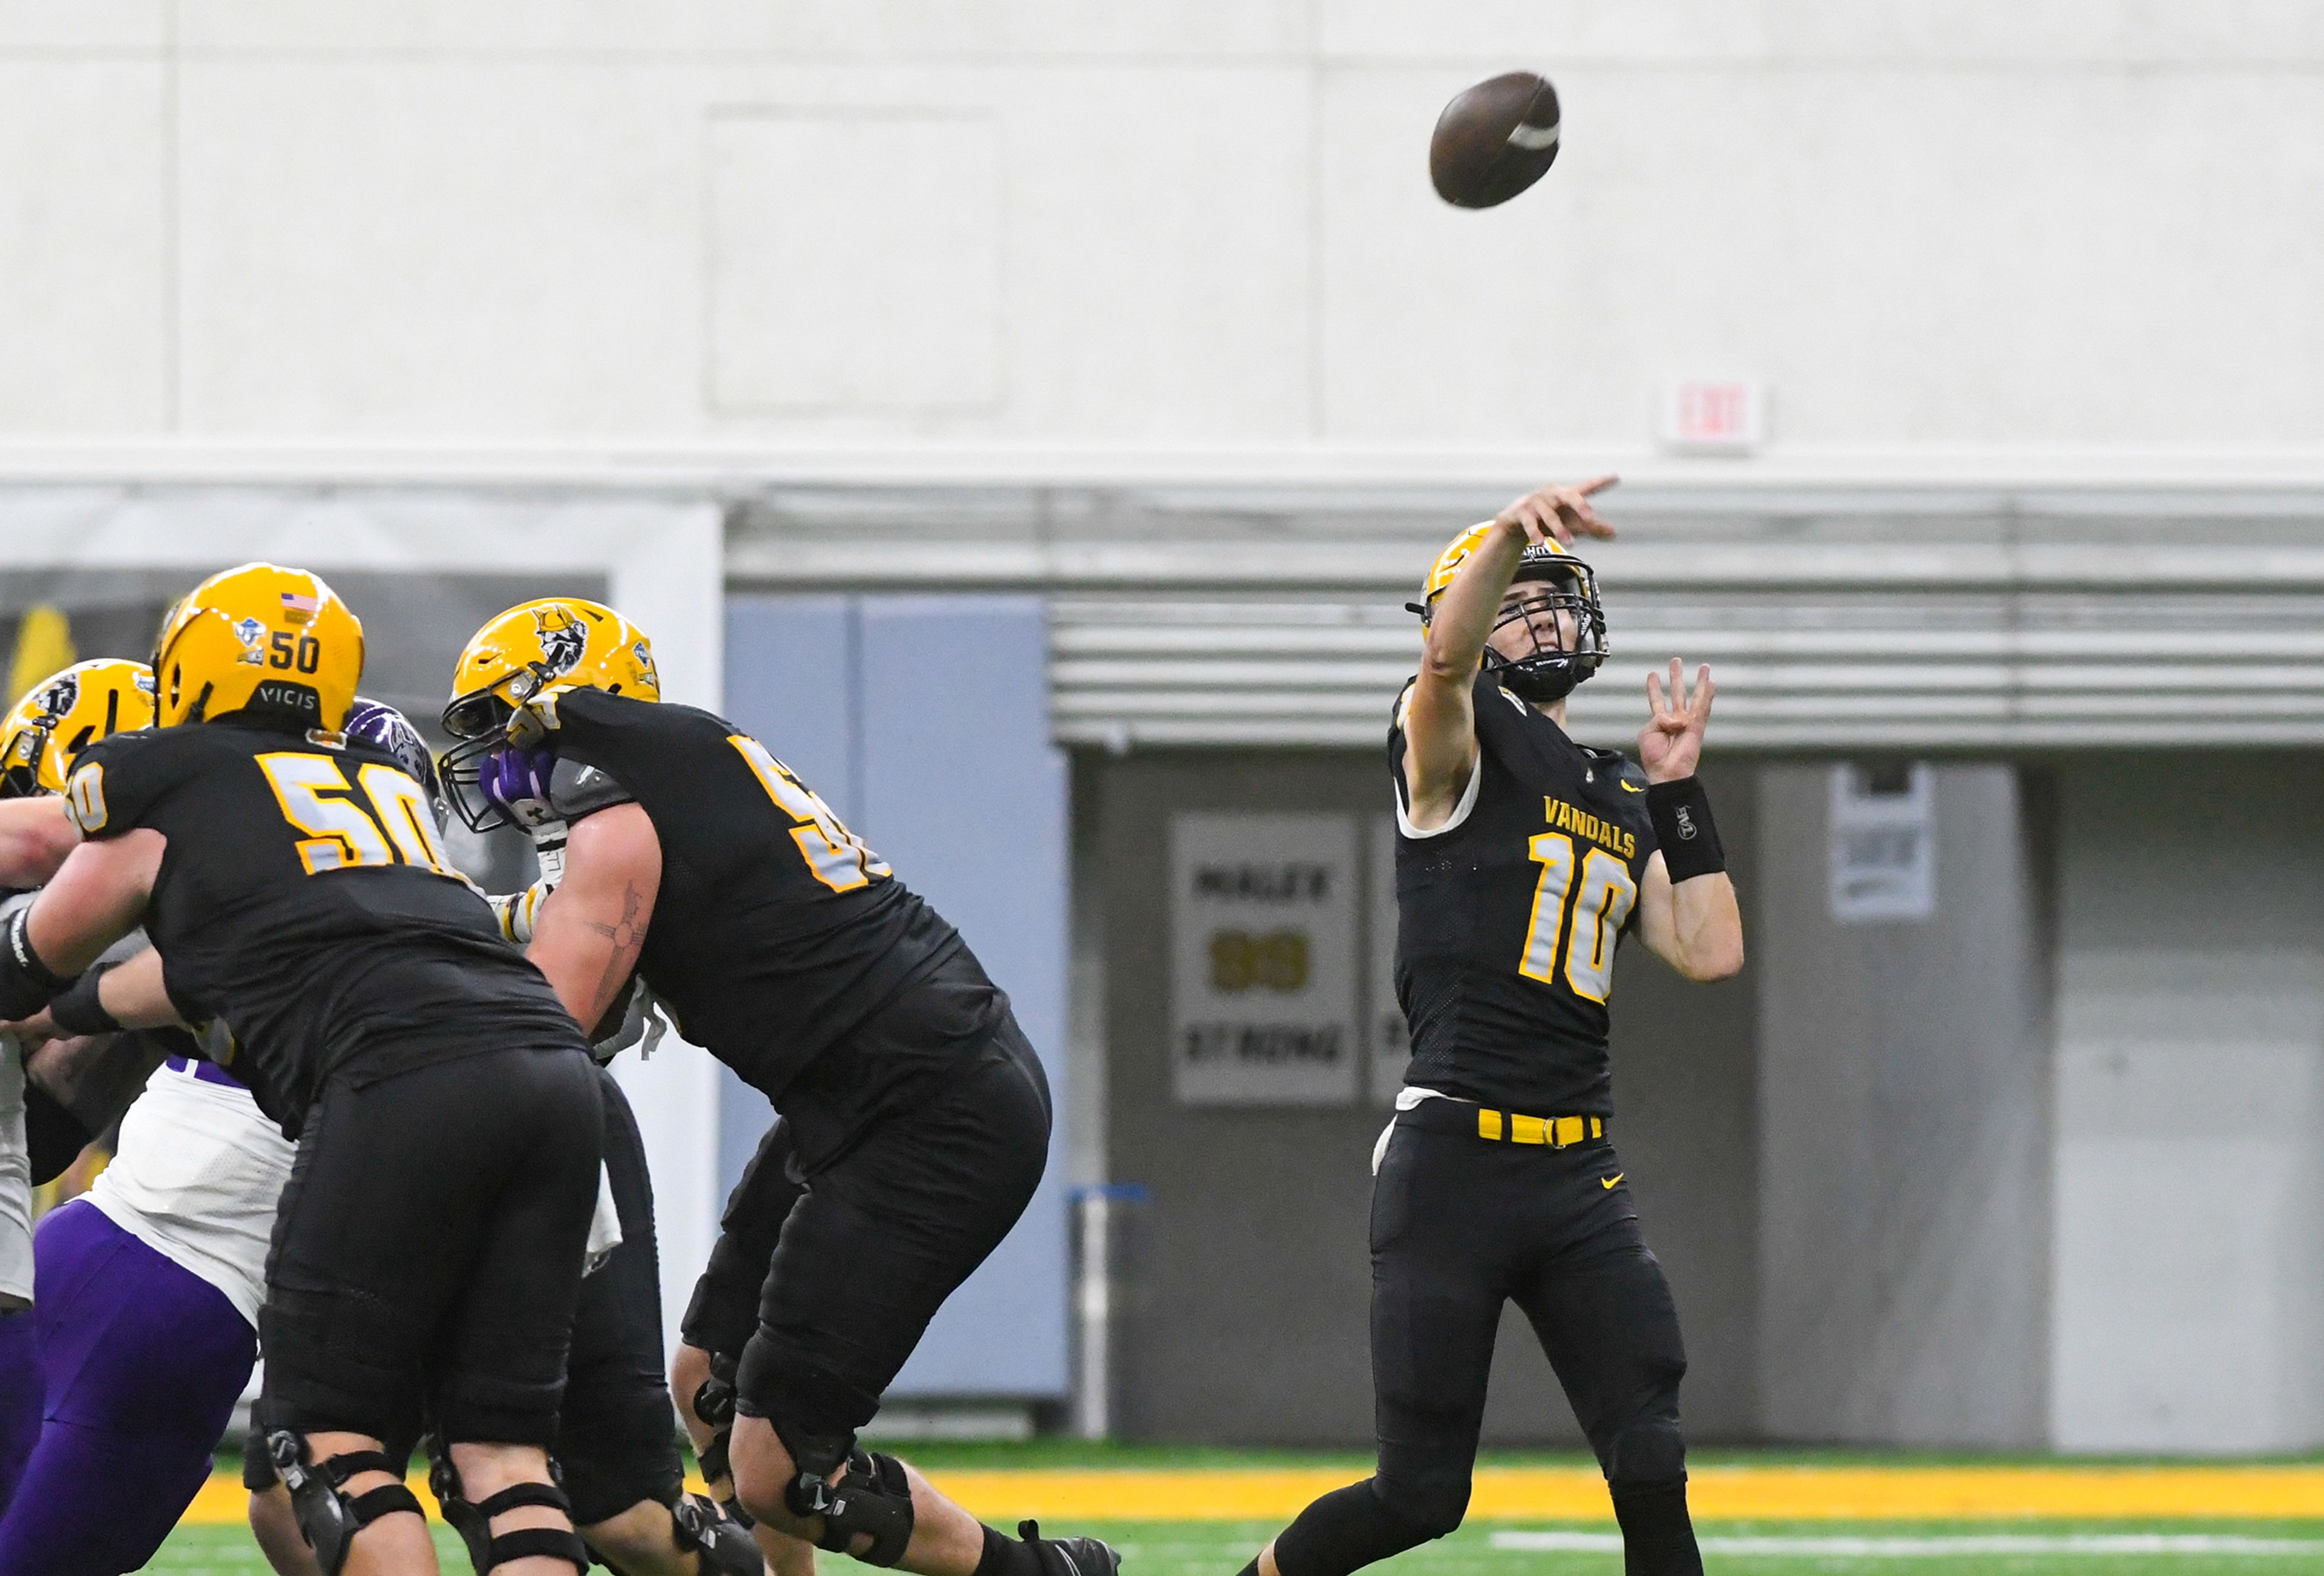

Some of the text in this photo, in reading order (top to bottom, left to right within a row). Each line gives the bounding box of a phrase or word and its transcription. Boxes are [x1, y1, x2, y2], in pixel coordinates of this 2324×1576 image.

[270, 631, 320, 674] 50
[260, 687, 316, 709] VICIS
[254, 752, 471, 887] 50
[1543, 795, 1635, 859] VANDALS
[1518, 832, 1638, 1007] 10
